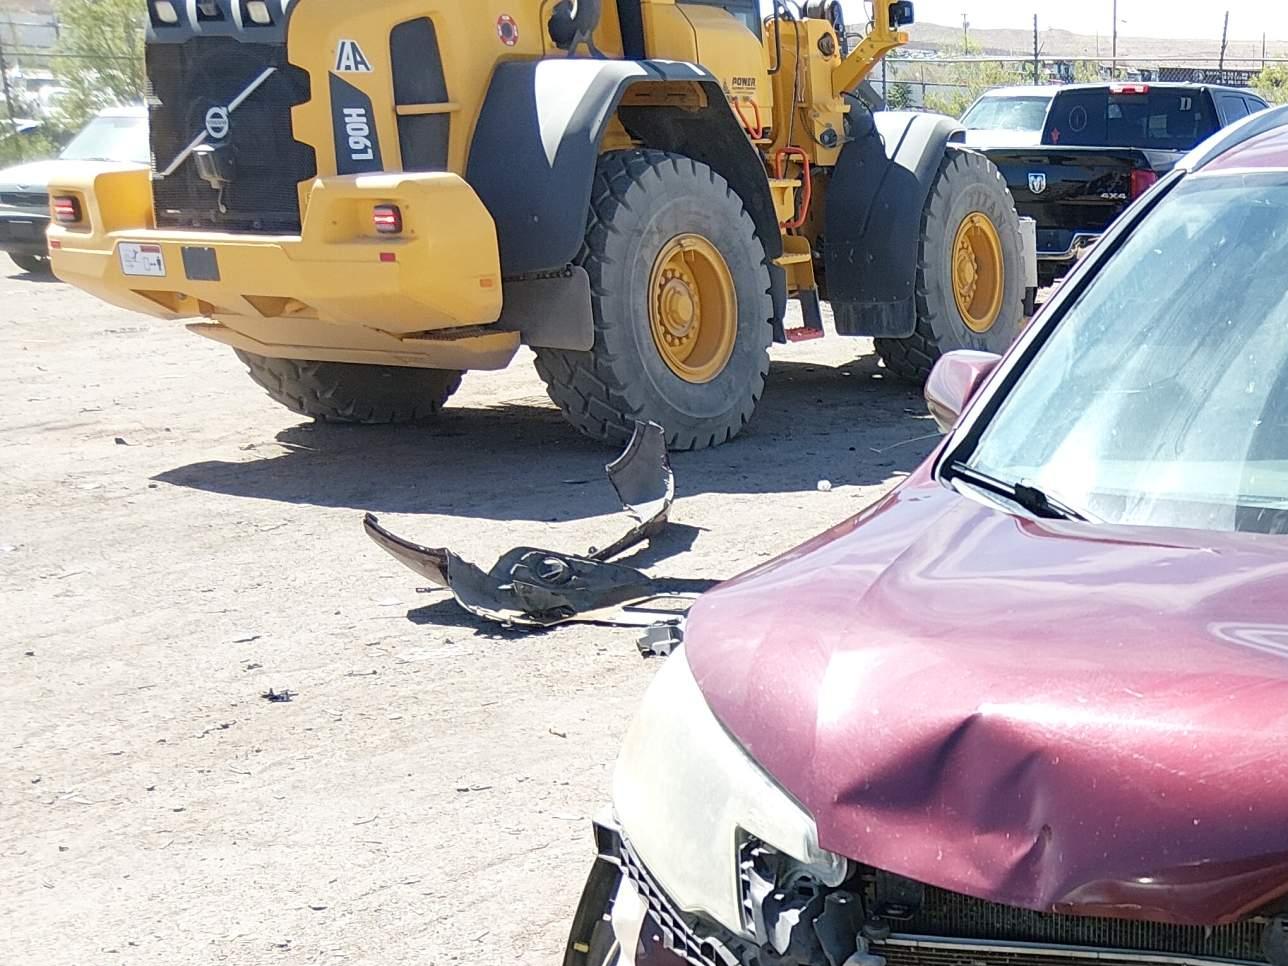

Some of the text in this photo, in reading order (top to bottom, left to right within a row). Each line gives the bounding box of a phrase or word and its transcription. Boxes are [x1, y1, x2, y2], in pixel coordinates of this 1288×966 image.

[336, 41, 371, 71] IAA
[732, 77, 756, 86] POWER
[342, 107, 374, 160] L90H
